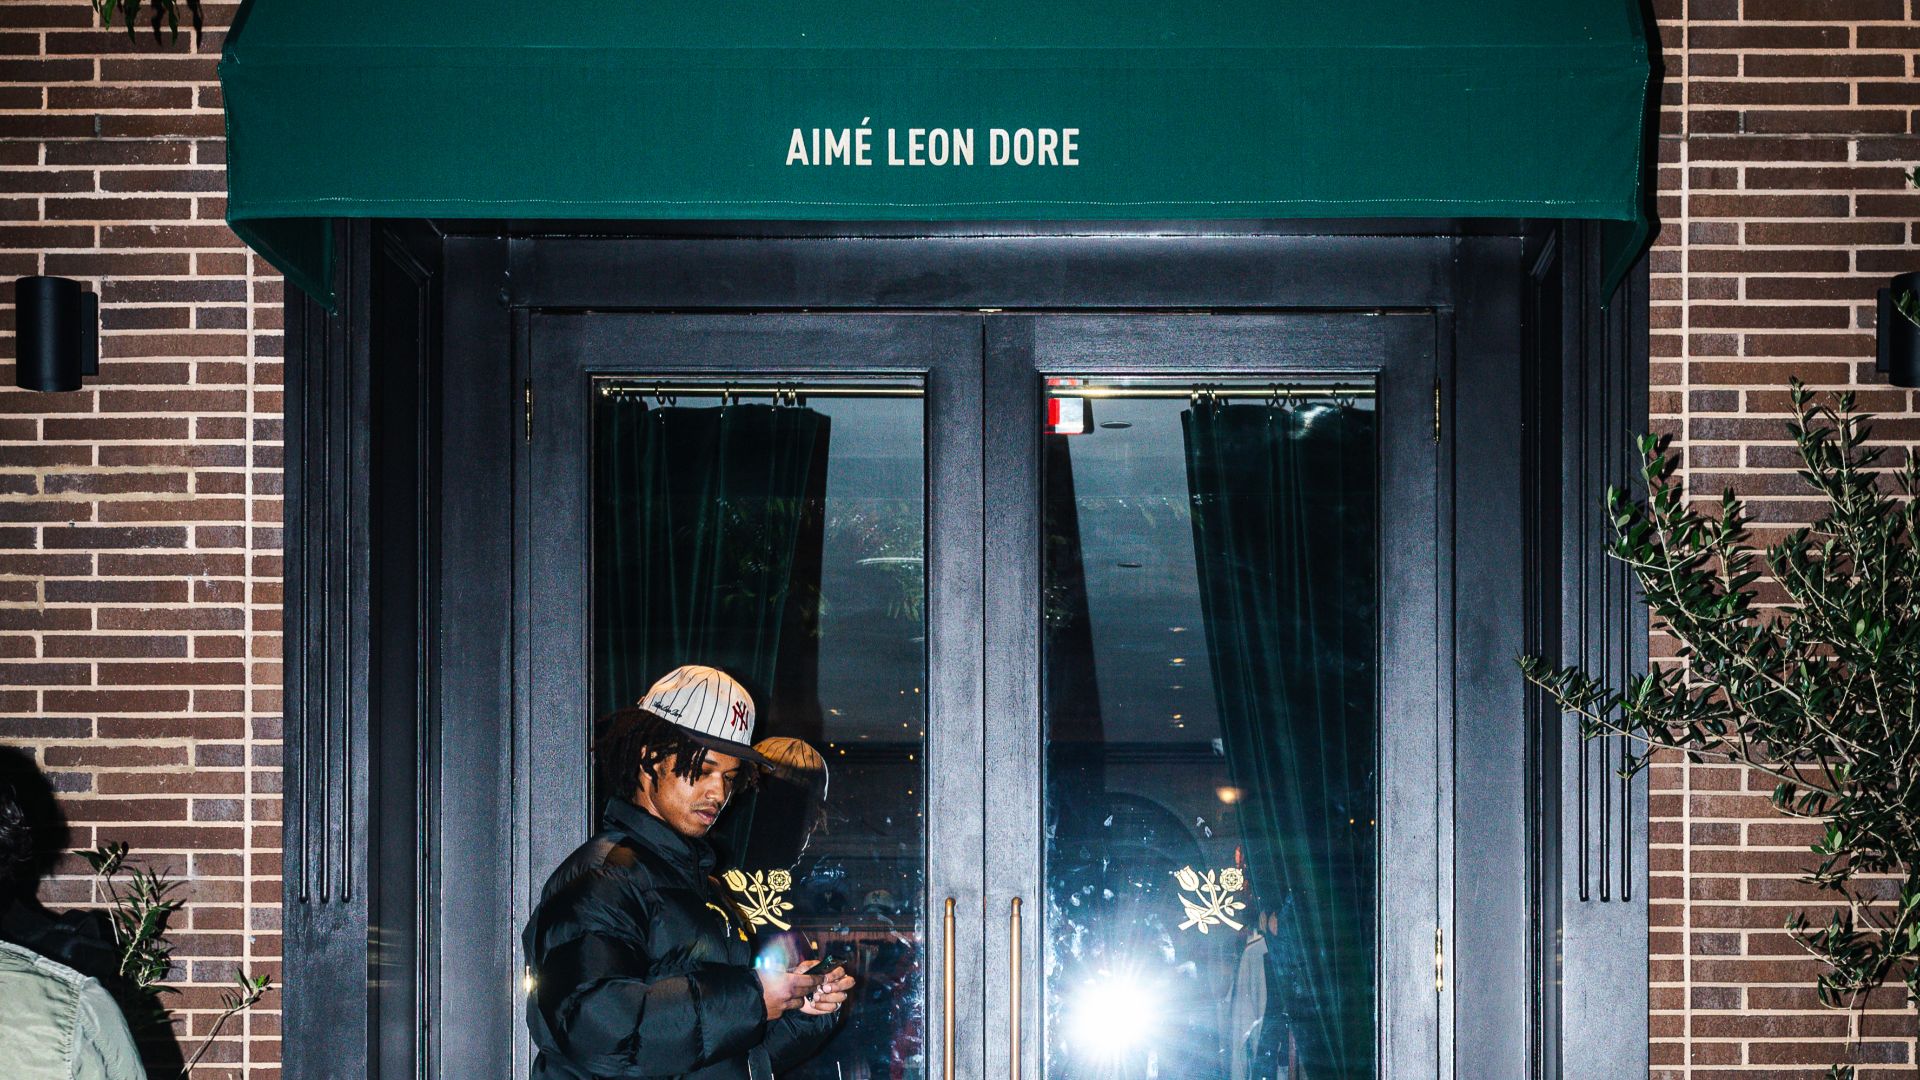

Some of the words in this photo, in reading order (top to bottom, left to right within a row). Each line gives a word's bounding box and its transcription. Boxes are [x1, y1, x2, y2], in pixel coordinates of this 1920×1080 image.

[786, 117, 872, 166] AIMÉ
[888, 128, 974, 166] LEON
[989, 128, 1080, 166] DORE
[731, 701, 749, 731] NY
